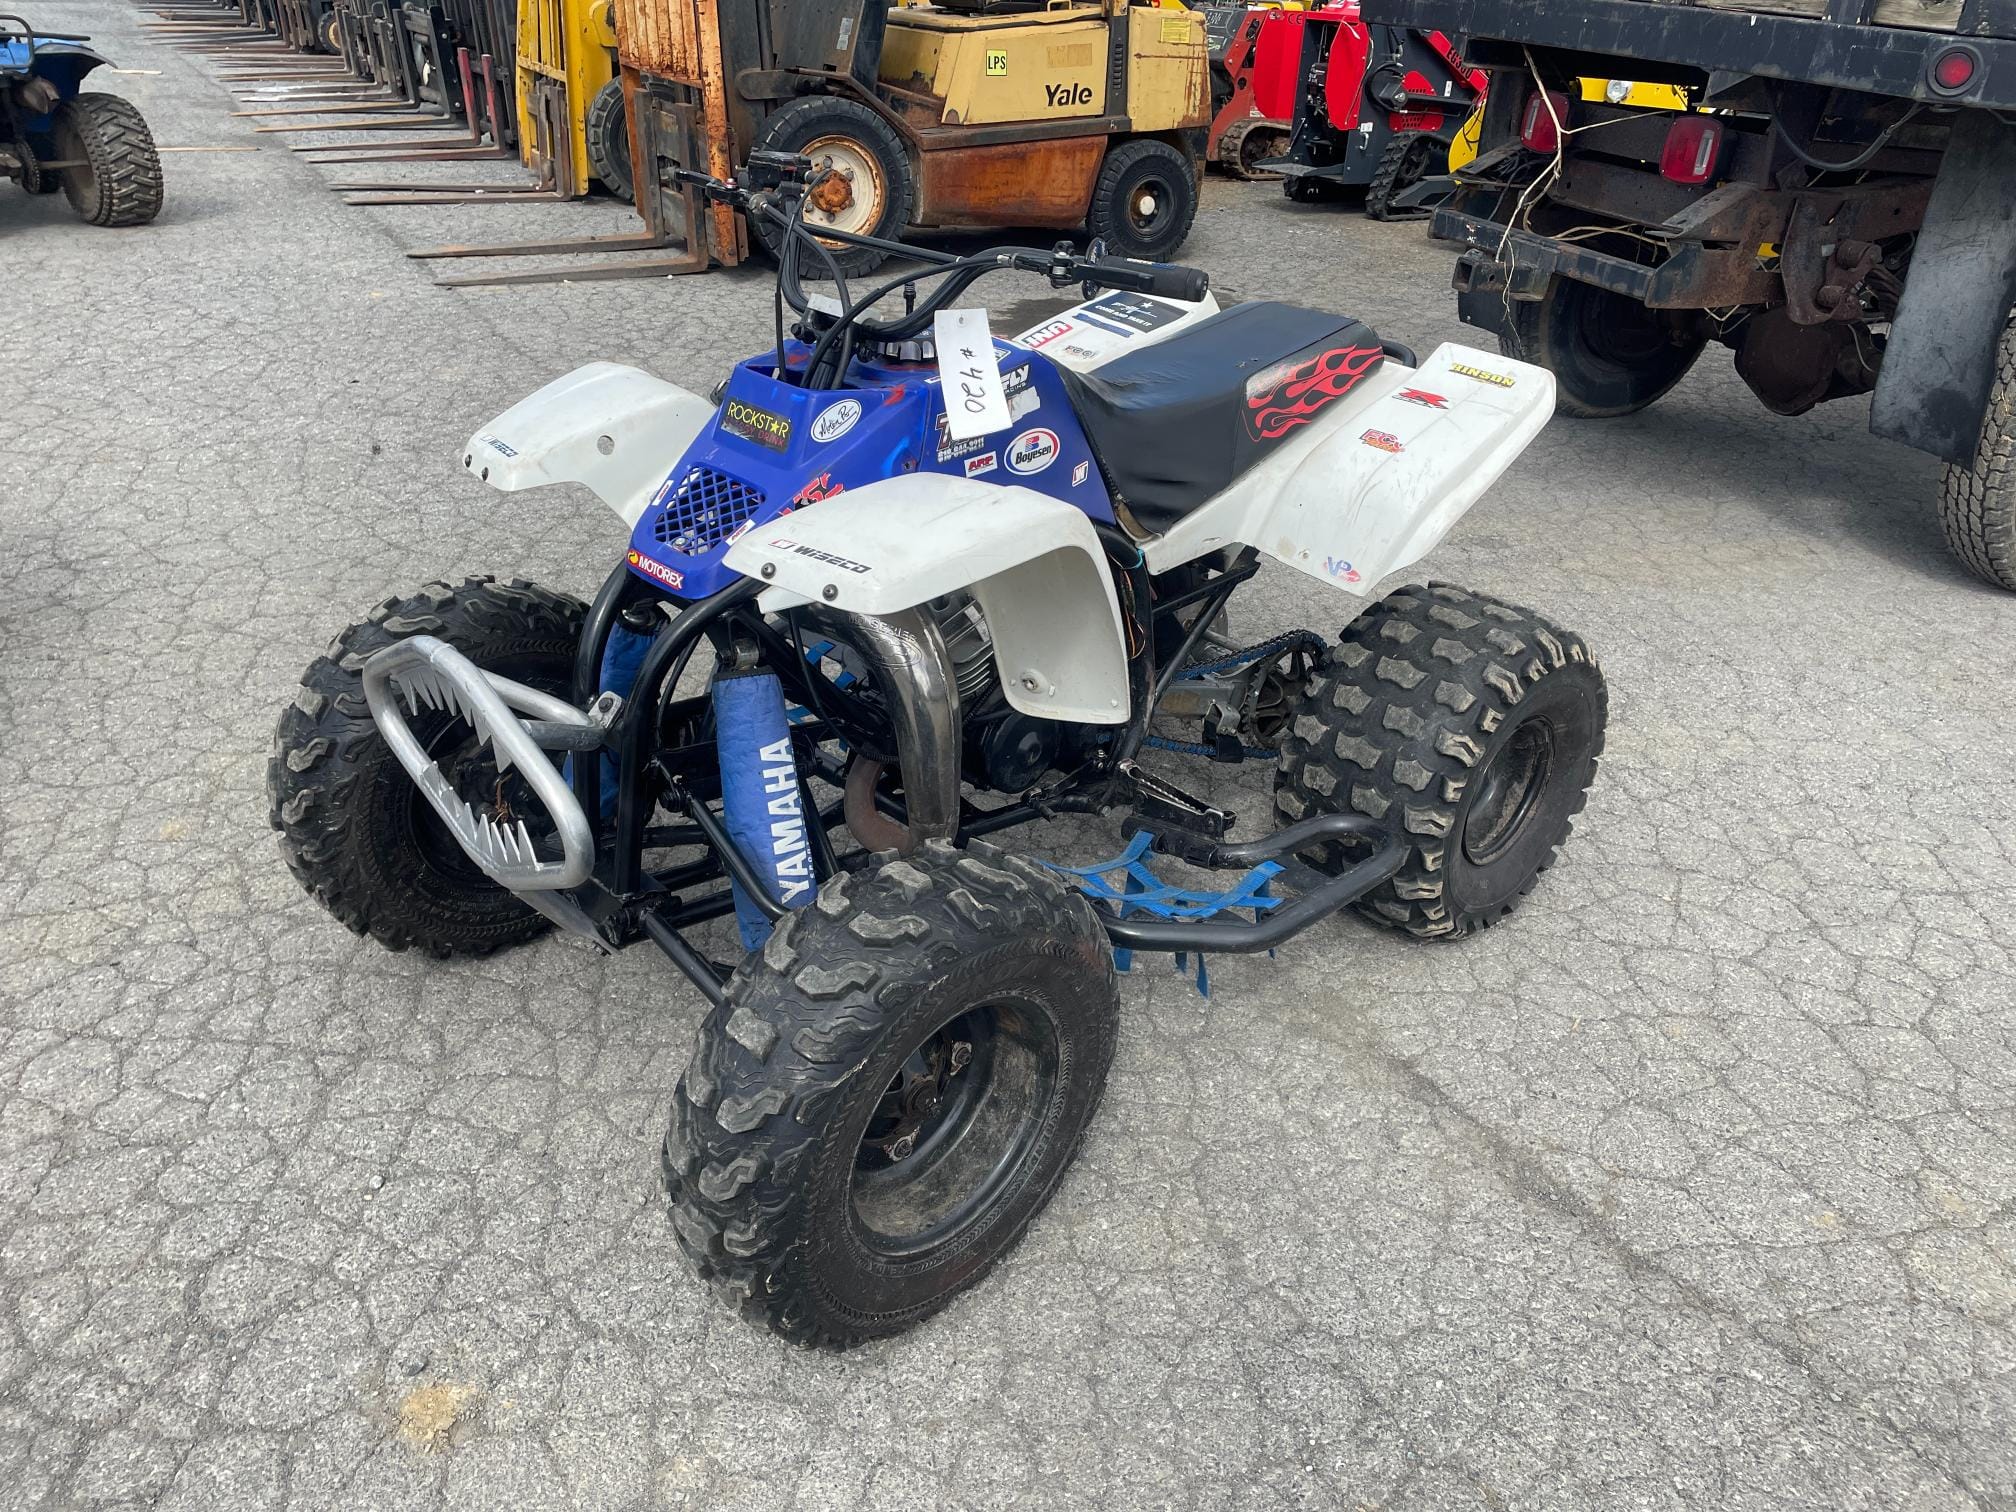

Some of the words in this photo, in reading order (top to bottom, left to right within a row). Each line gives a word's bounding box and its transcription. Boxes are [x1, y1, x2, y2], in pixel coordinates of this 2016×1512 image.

[988, 56, 1006, 70] LPS
[1045, 83, 1093, 107] Yale
[968, 456, 994, 472] ARP
[1015, 445, 1051, 465] Boyesen
[639, 555, 684, 588] MOTOREX
[759, 737, 810, 904] YAMAHA
